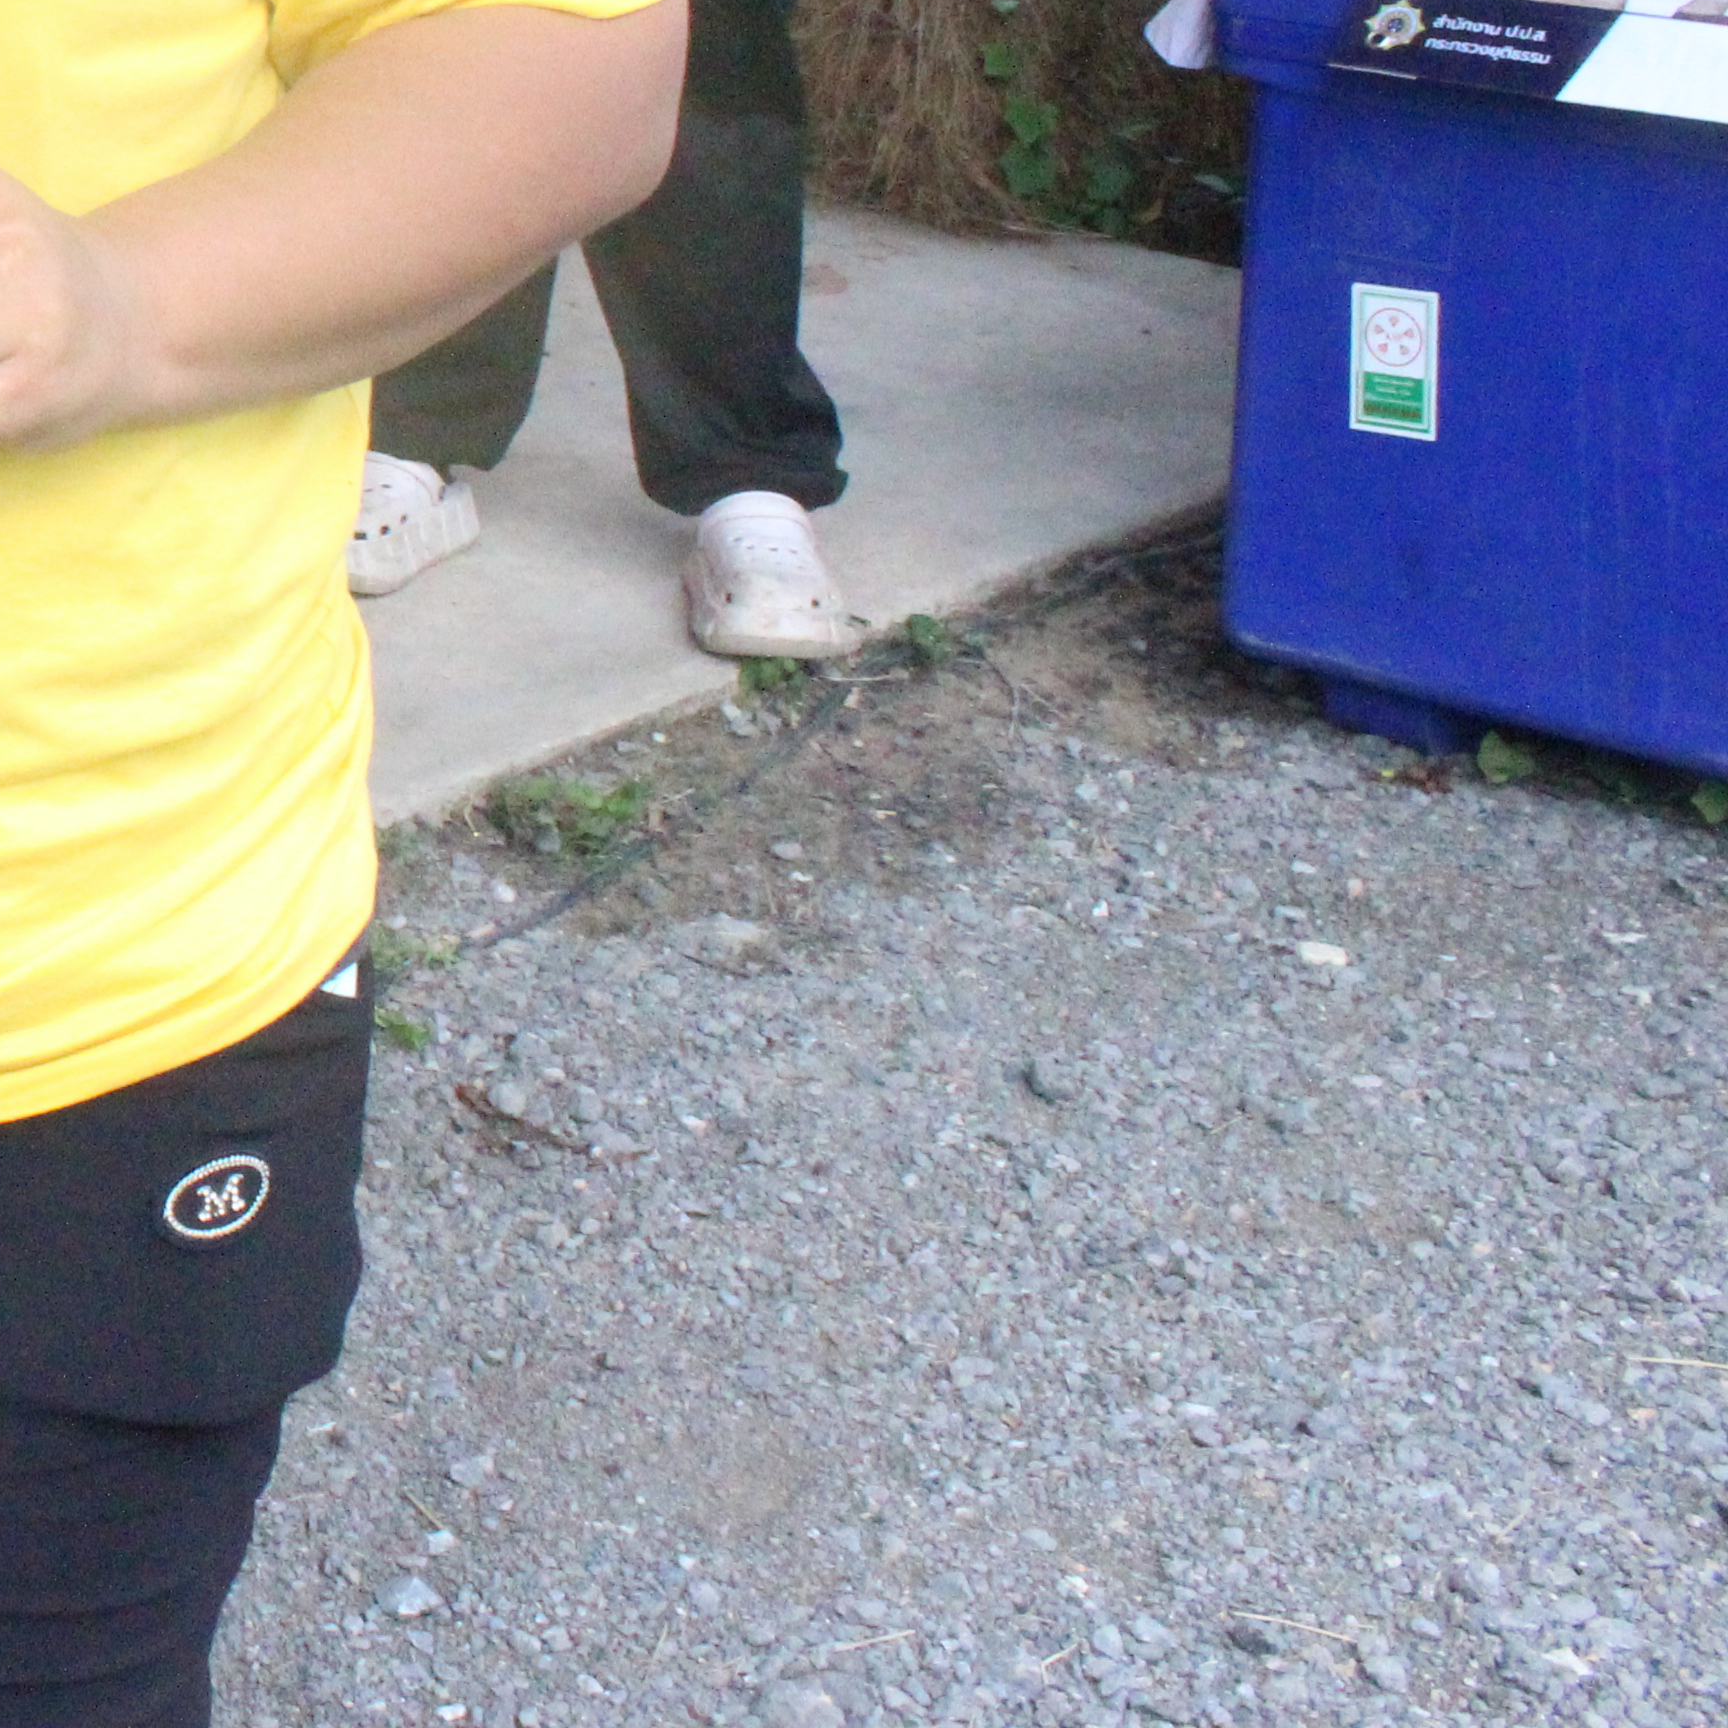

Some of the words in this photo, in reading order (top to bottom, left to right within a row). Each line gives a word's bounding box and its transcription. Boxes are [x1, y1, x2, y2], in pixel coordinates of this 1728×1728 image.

[1432, 14, 1501, 36] สำนักงาน
[1424, 38, 1553, 65] กระทรวงยุติธรรม
